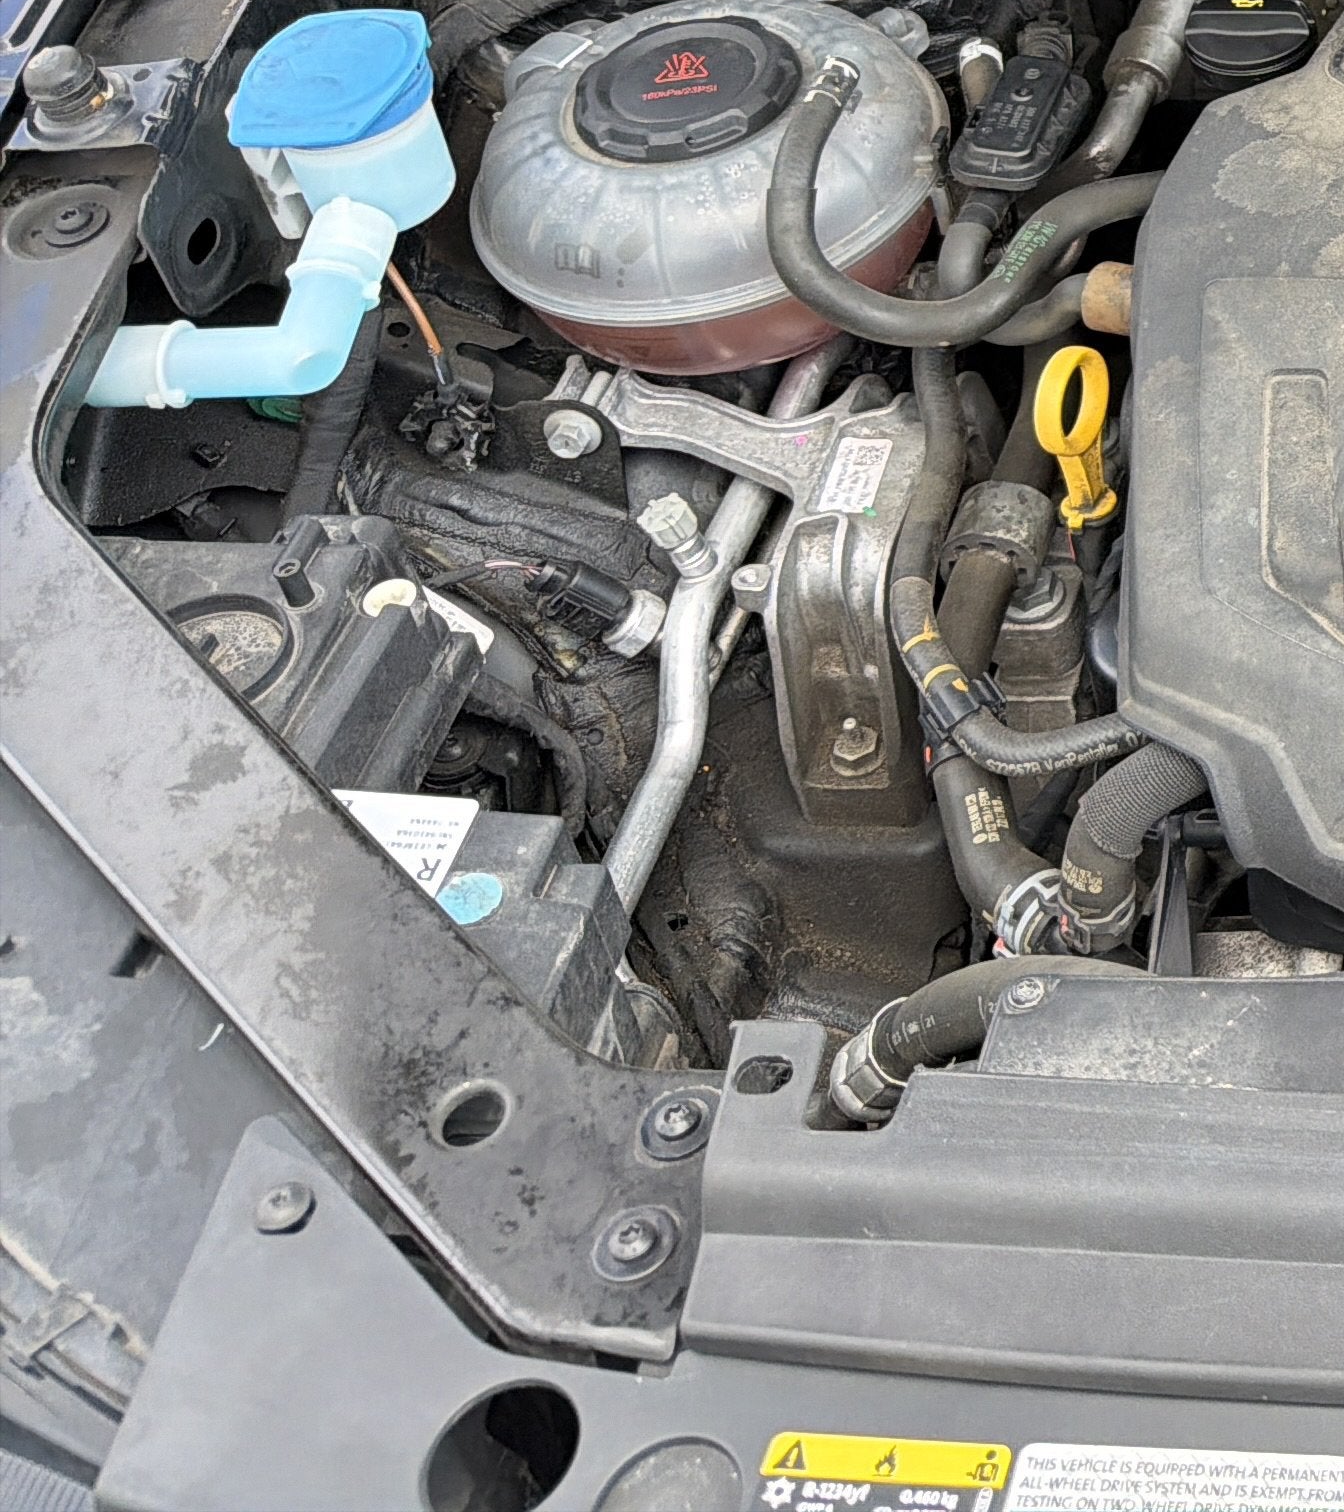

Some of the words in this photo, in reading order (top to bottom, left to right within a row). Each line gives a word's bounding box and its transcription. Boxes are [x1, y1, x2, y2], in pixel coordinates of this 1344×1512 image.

[416, 857, 442, 882] R
[1027, 1457, 1056, 1471] THIS
[1061, 1458, 1117, 1474] VEHICLE
[1120, 1461, 1132, 1474] IS
[1135, 1462, 1205, 1477] EQUIPPED
[1209, 1465, 1246, 1479] WITH
[1248, 1467, 1259, 1479] A
[900, 1489, 941, 1505] 0.460
[941, 1491, 959, 1509] kg
[1019, 1476, 1096, 1492] ALL-WHEEL
[1100, 1479, 1142, 1493] DRIVE
[1145, 1481, 1196, 1495] SYSTEM
[1198, 1483, 1232, 1496] AND
[1234, 1485, 1247, 1497] IS
[1251, 1485, 1305, 1500] EXEMPT
[1017, 1494, 1073, 1509] TESTING
[1076, 1496, 1099, 1510] ON
[1103, 1498, 1136, 1511] TWO
